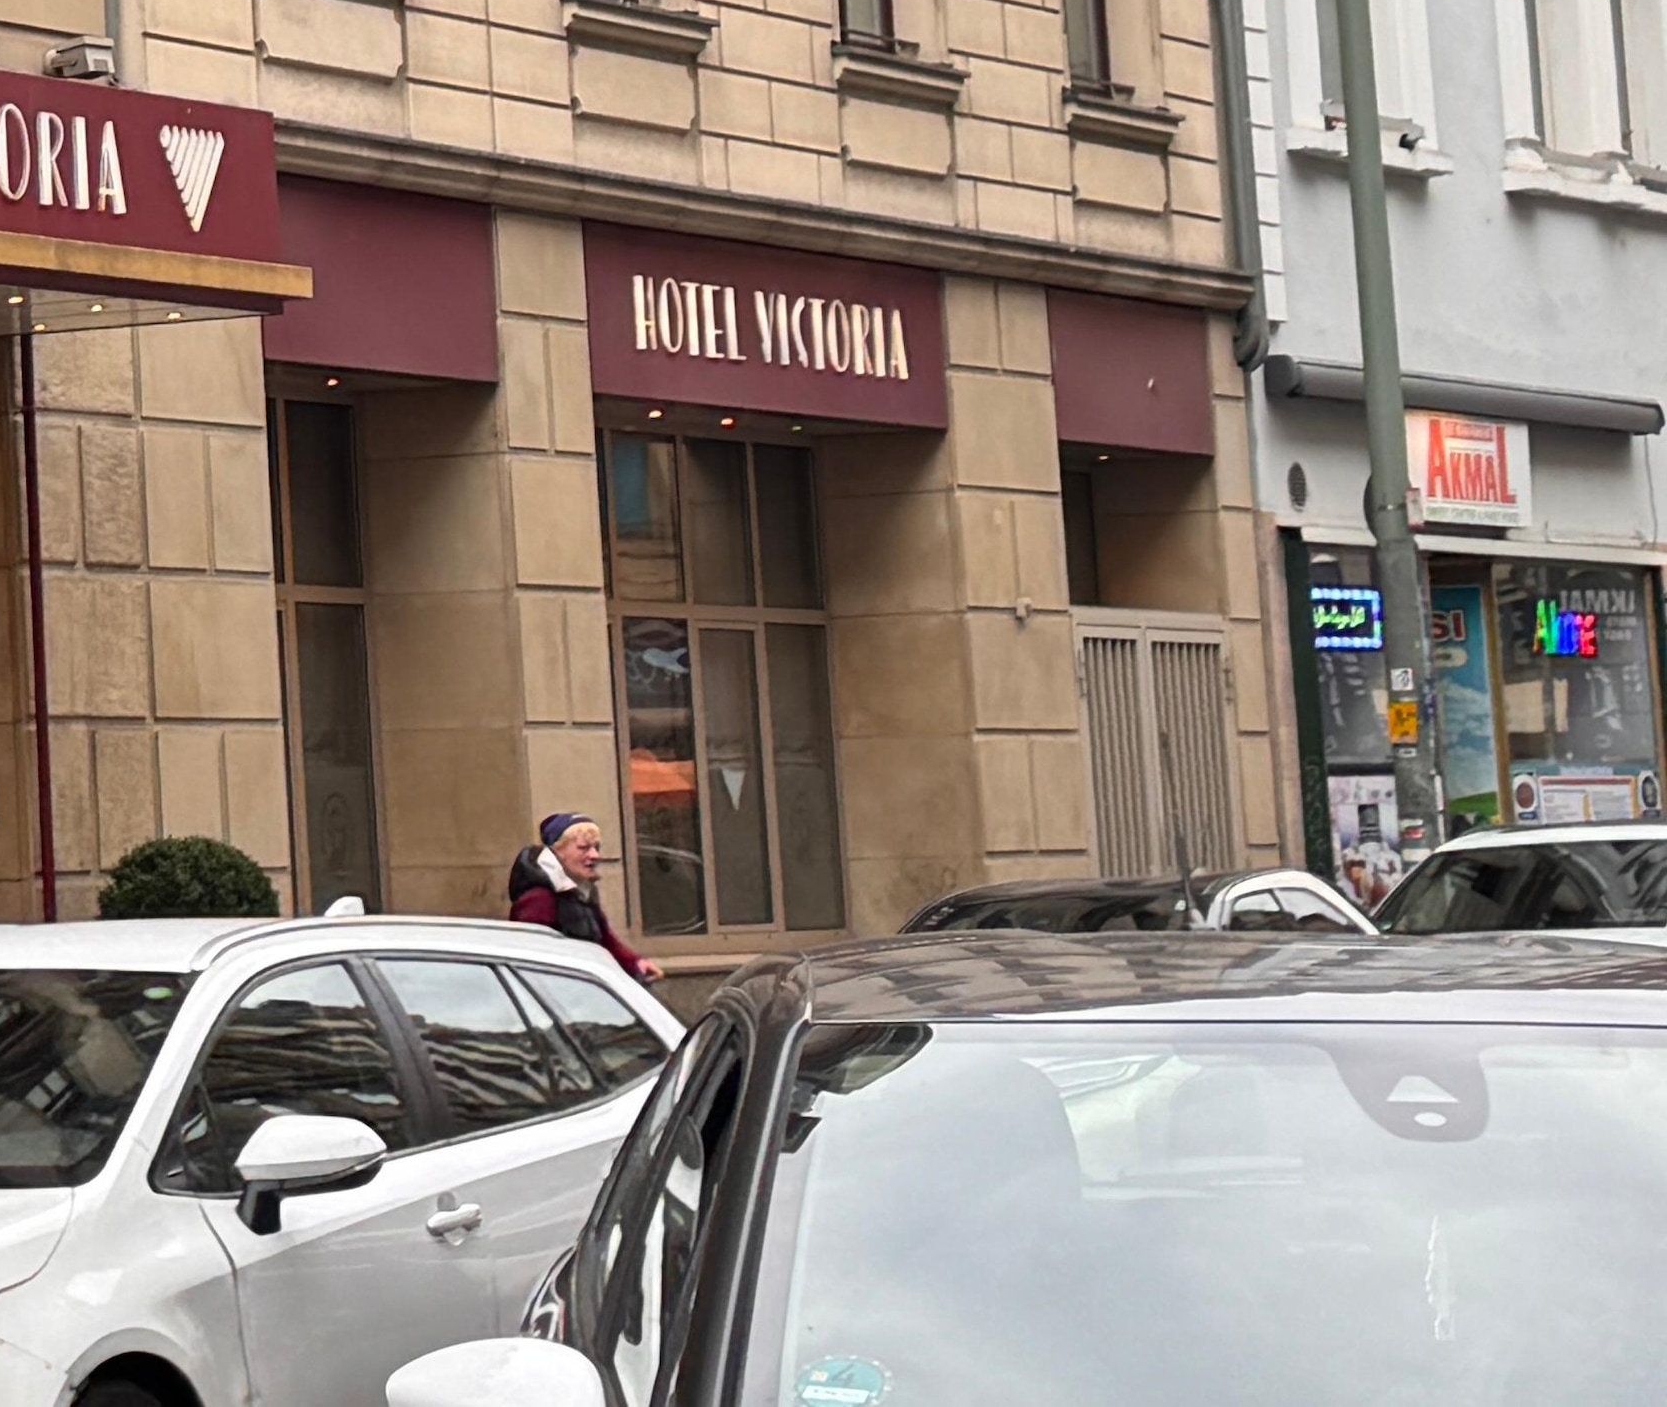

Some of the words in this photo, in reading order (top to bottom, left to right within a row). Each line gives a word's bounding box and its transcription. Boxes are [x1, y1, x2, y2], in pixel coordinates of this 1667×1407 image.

[632, 274, 748, 361] HOTEL
[753, 290, 909, 380] VICTORIA
[1427, 419, 1517, 504] AKMAL
